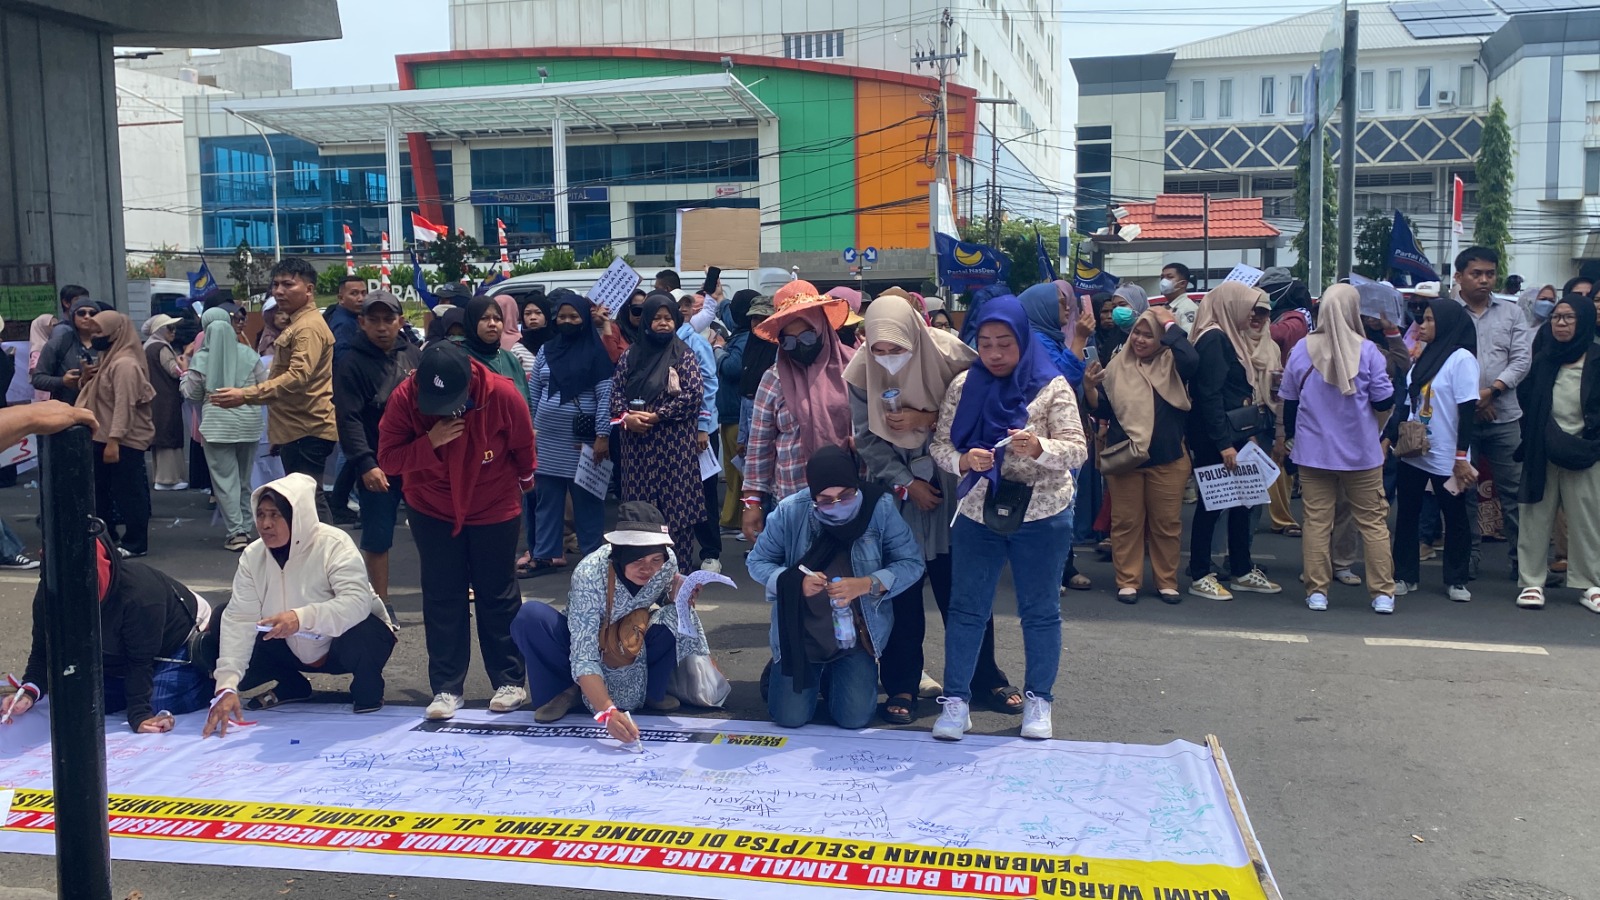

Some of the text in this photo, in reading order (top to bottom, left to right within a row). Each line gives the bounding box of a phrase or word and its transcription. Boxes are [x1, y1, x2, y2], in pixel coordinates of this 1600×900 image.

[1394, 249, 1418, 262] Partai
[620, 274, 633, 290] DAN
[946, 268, 968, 276] Partai
[593, 263, 626, 302] KESEHATAN
[1198, 466, 1231, 483] POLUSI
[1205, 492, 1230, 501] DEPAN
[250, 806, 305, 821] KEC.
[307, 808, 405, 828] SUTAMI,
[411, 817, 444, 830] IR.
[215, 821, 242, 838] 6,
[241, 824, 331, 844] NEGERI
[446, 818, 486, 831] JL.
[493, 818, 590, 838] ETERNO,
[327, 829, 392, 847] SMA
[397, 832, 543, 856] ALAMANDA,
[592, 825, 695, 846] GUDANG
[698, 832, 728, 848] DI
[551, 840, 651, 864] AKASIA,
[733, 835, 876, 860] PSEL/PTSa
[659, 847, 849, 880] TAMALA'LANG,
[882, 846, 1089, 876] PEMBANGUNAN
[861, 864, 941, 888] BARU,
[951, 872, 1030, 894] MULA
[1041, 877, 1143, 900] WARGA
[1153, 887, 1230, 900] KAMI
